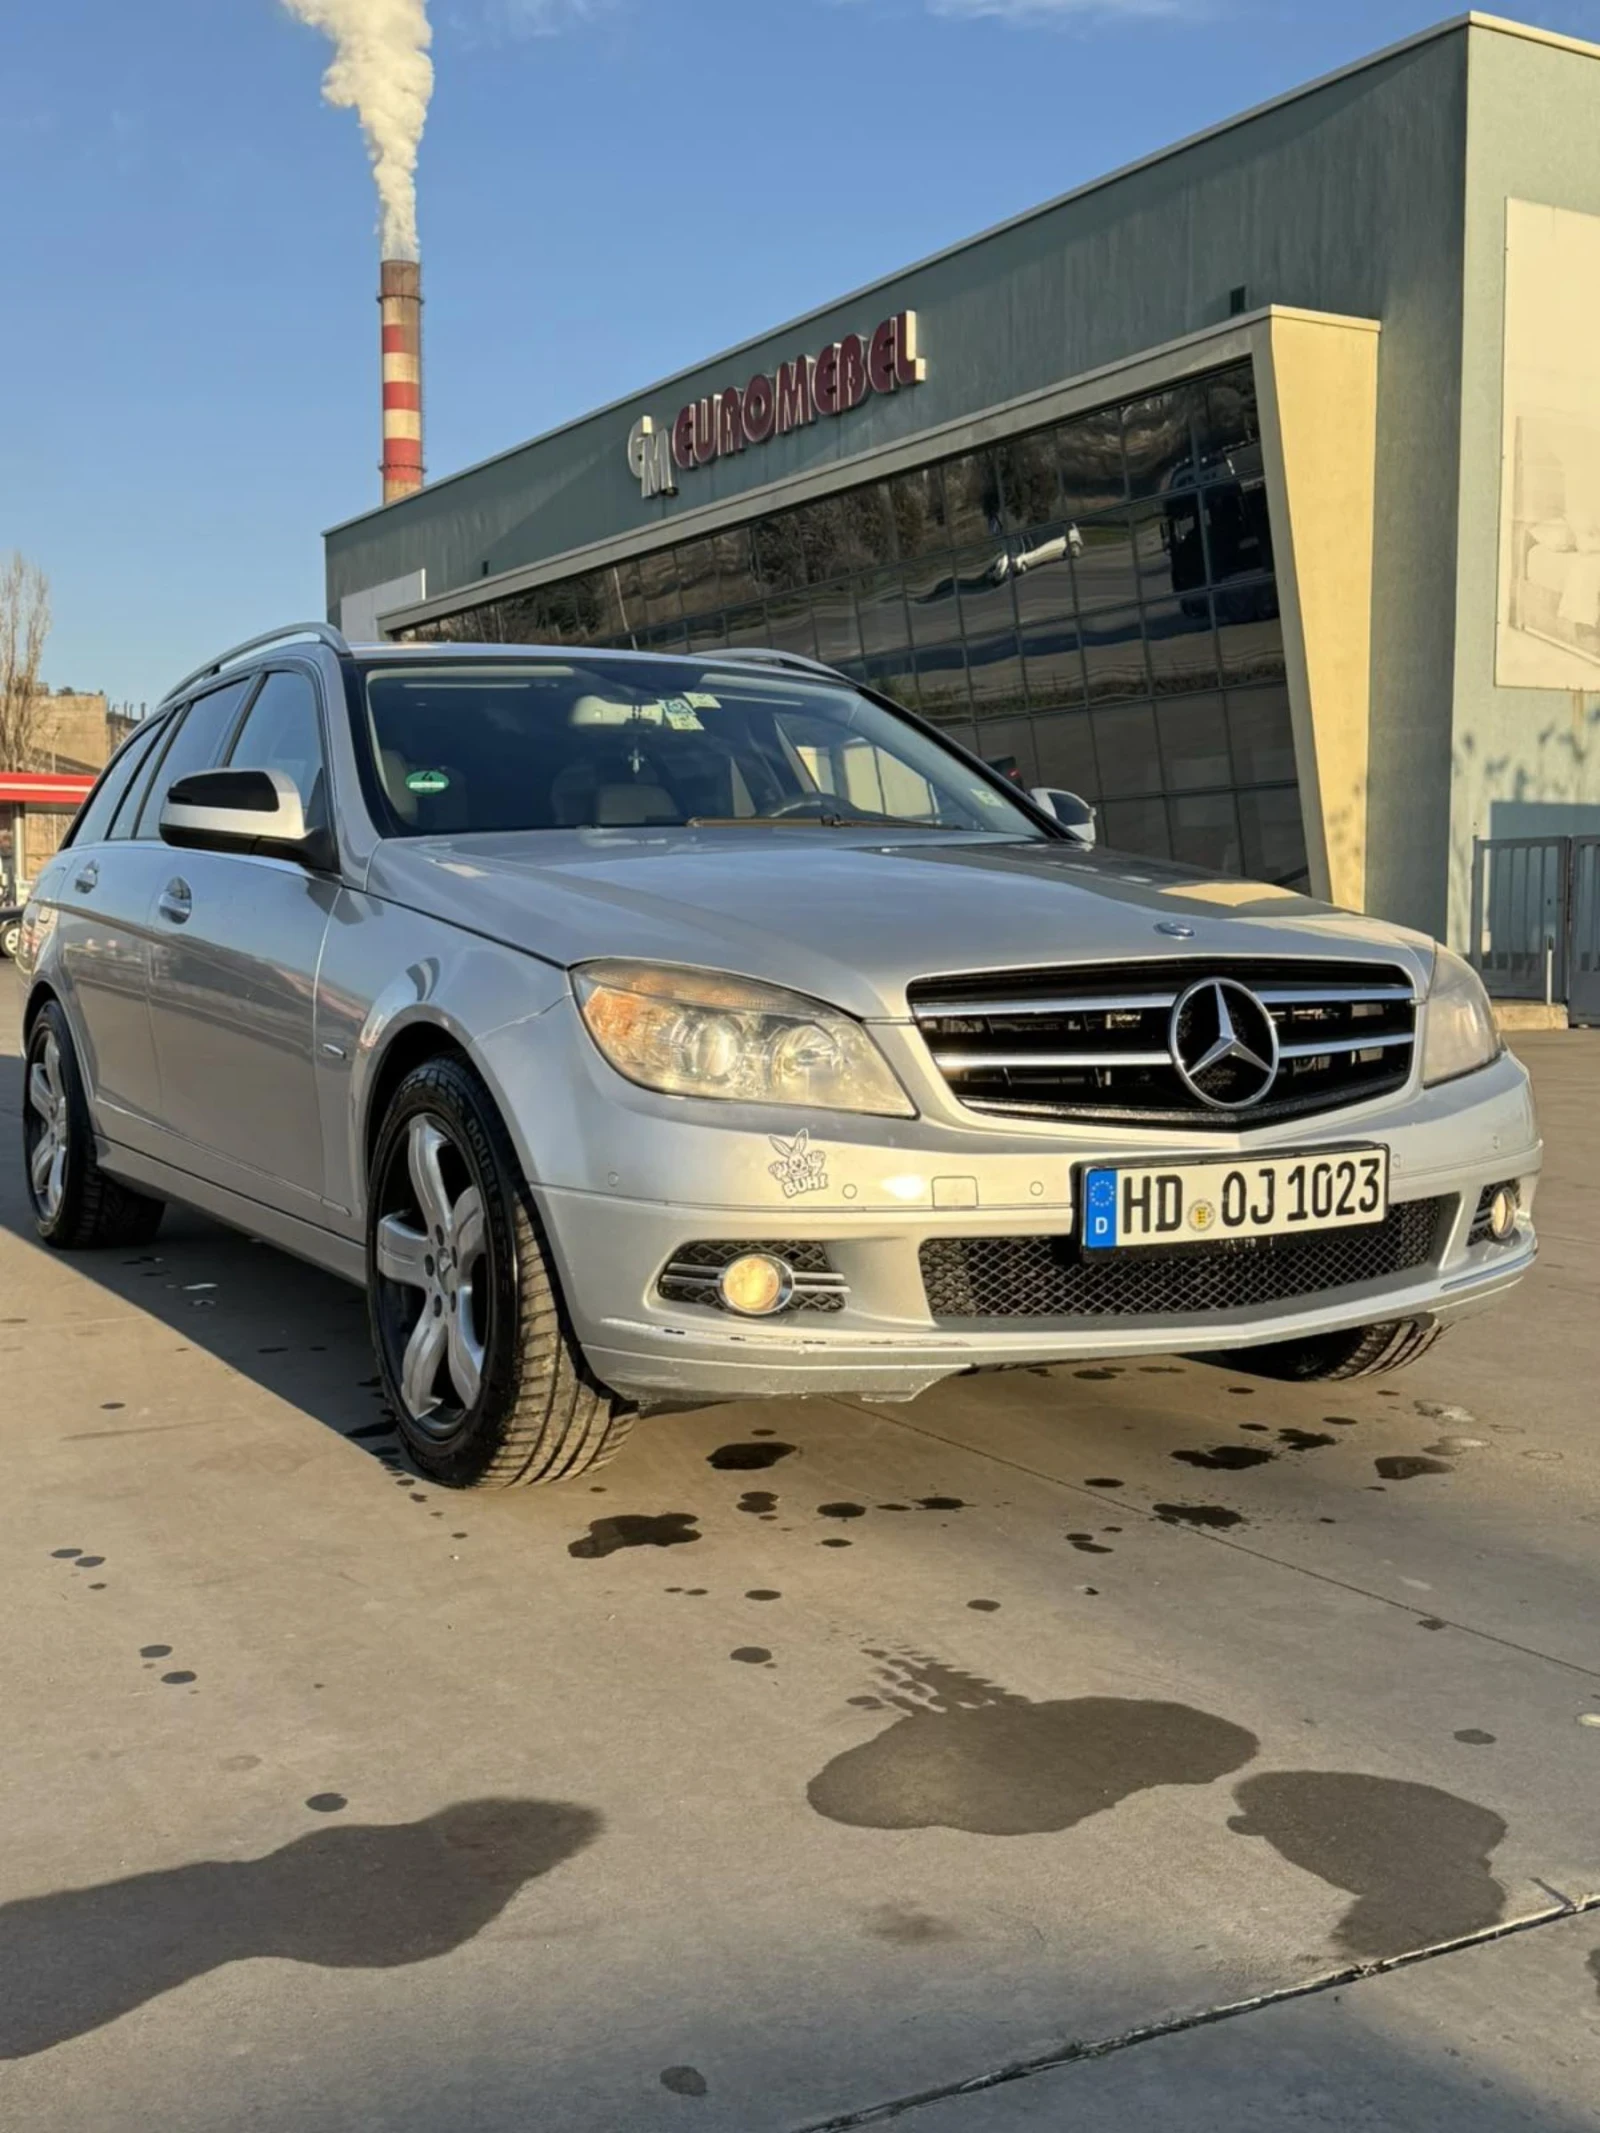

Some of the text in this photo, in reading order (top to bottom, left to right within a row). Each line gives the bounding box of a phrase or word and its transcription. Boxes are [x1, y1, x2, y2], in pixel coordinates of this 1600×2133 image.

[672, 310, 926, 470] EUROMEBEL
[1095, 1217, 1108, 1234] D
[1123, 1158, 1381, 1234] HD OJ 1023
